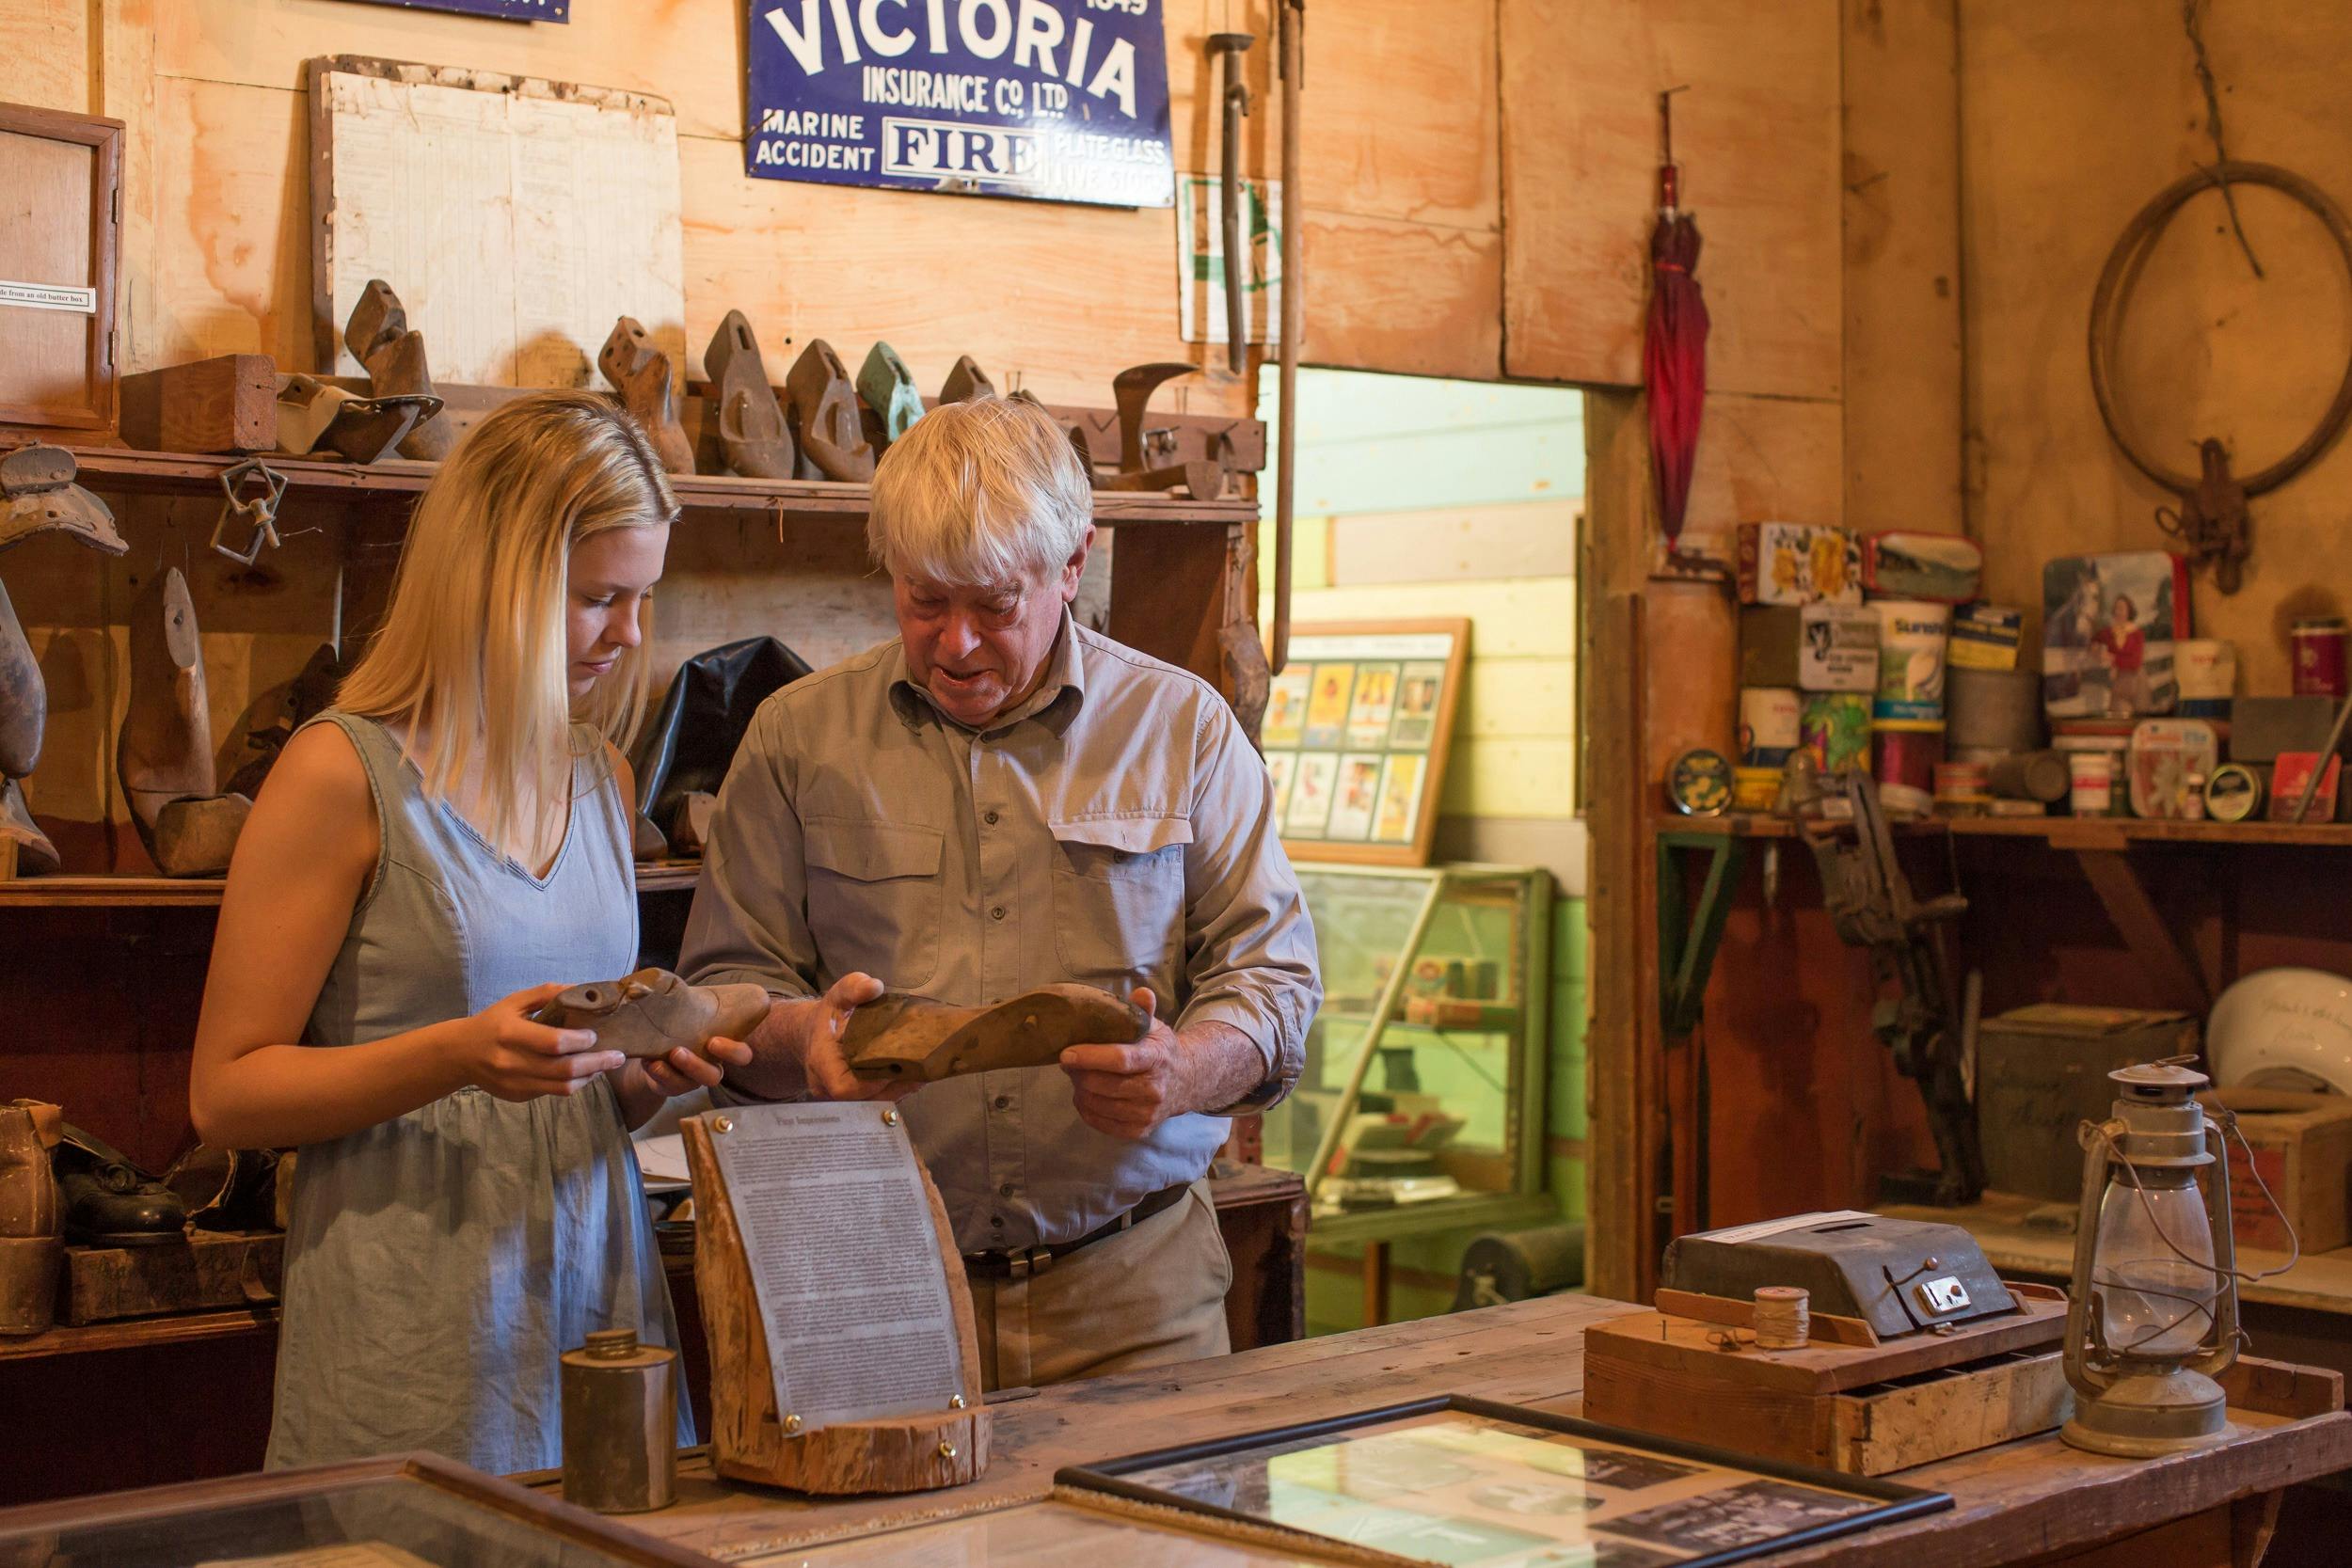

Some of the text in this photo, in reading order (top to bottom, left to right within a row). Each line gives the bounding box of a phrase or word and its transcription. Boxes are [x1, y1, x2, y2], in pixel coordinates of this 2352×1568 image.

[765, 0, 1136, 119] VICTORIA
[863, 65, 989, 113] INSURANCE
[762, 108, 865, 140] MARINE
[755, 140, 875, 172] ACCIDENT
[893, 124, 1038, 176] FIRE
